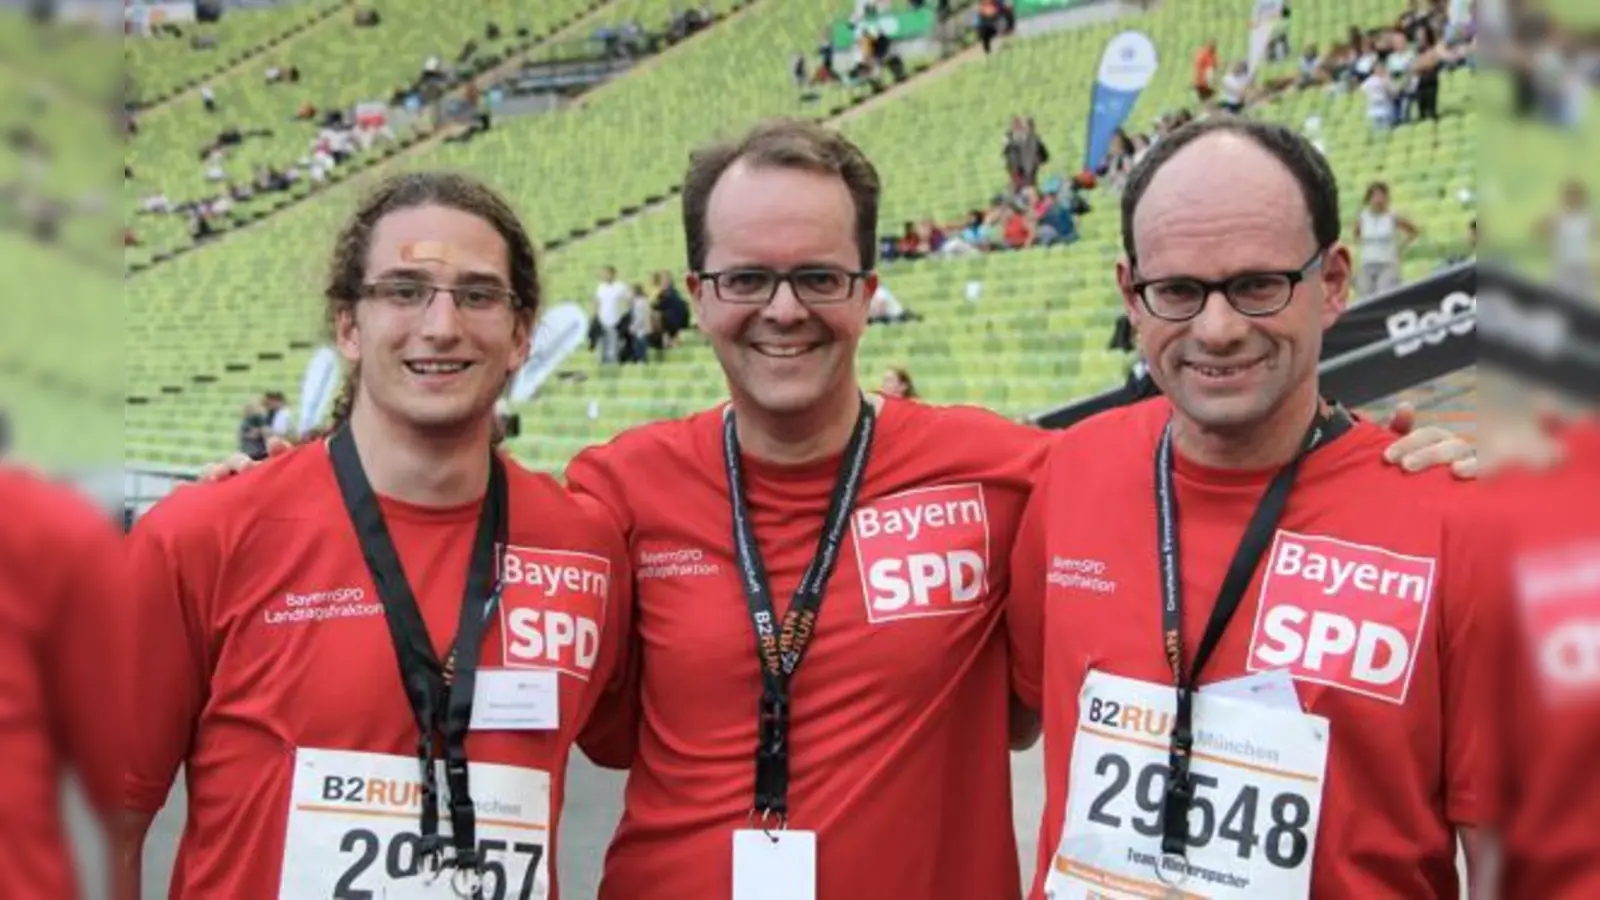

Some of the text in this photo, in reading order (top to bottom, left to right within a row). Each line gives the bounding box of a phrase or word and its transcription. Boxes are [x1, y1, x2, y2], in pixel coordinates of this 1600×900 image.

[1386, 291, 1476, 357] BoC
[856, 499, 982, 541] Bayern
[285, 587, 365, 607] BayernSPD
[504, 554, 607, 598] Bayern
[869, 549, 985, 611] SPD
[1274, 542, 1426, 603] Bayern
[509, 607, 599, 669] SPD
[1255, 604, 1409, 686] SPD
[1089, 697, 1178, 736] B2RU
[1087, 753, 1311, 869] 29548
